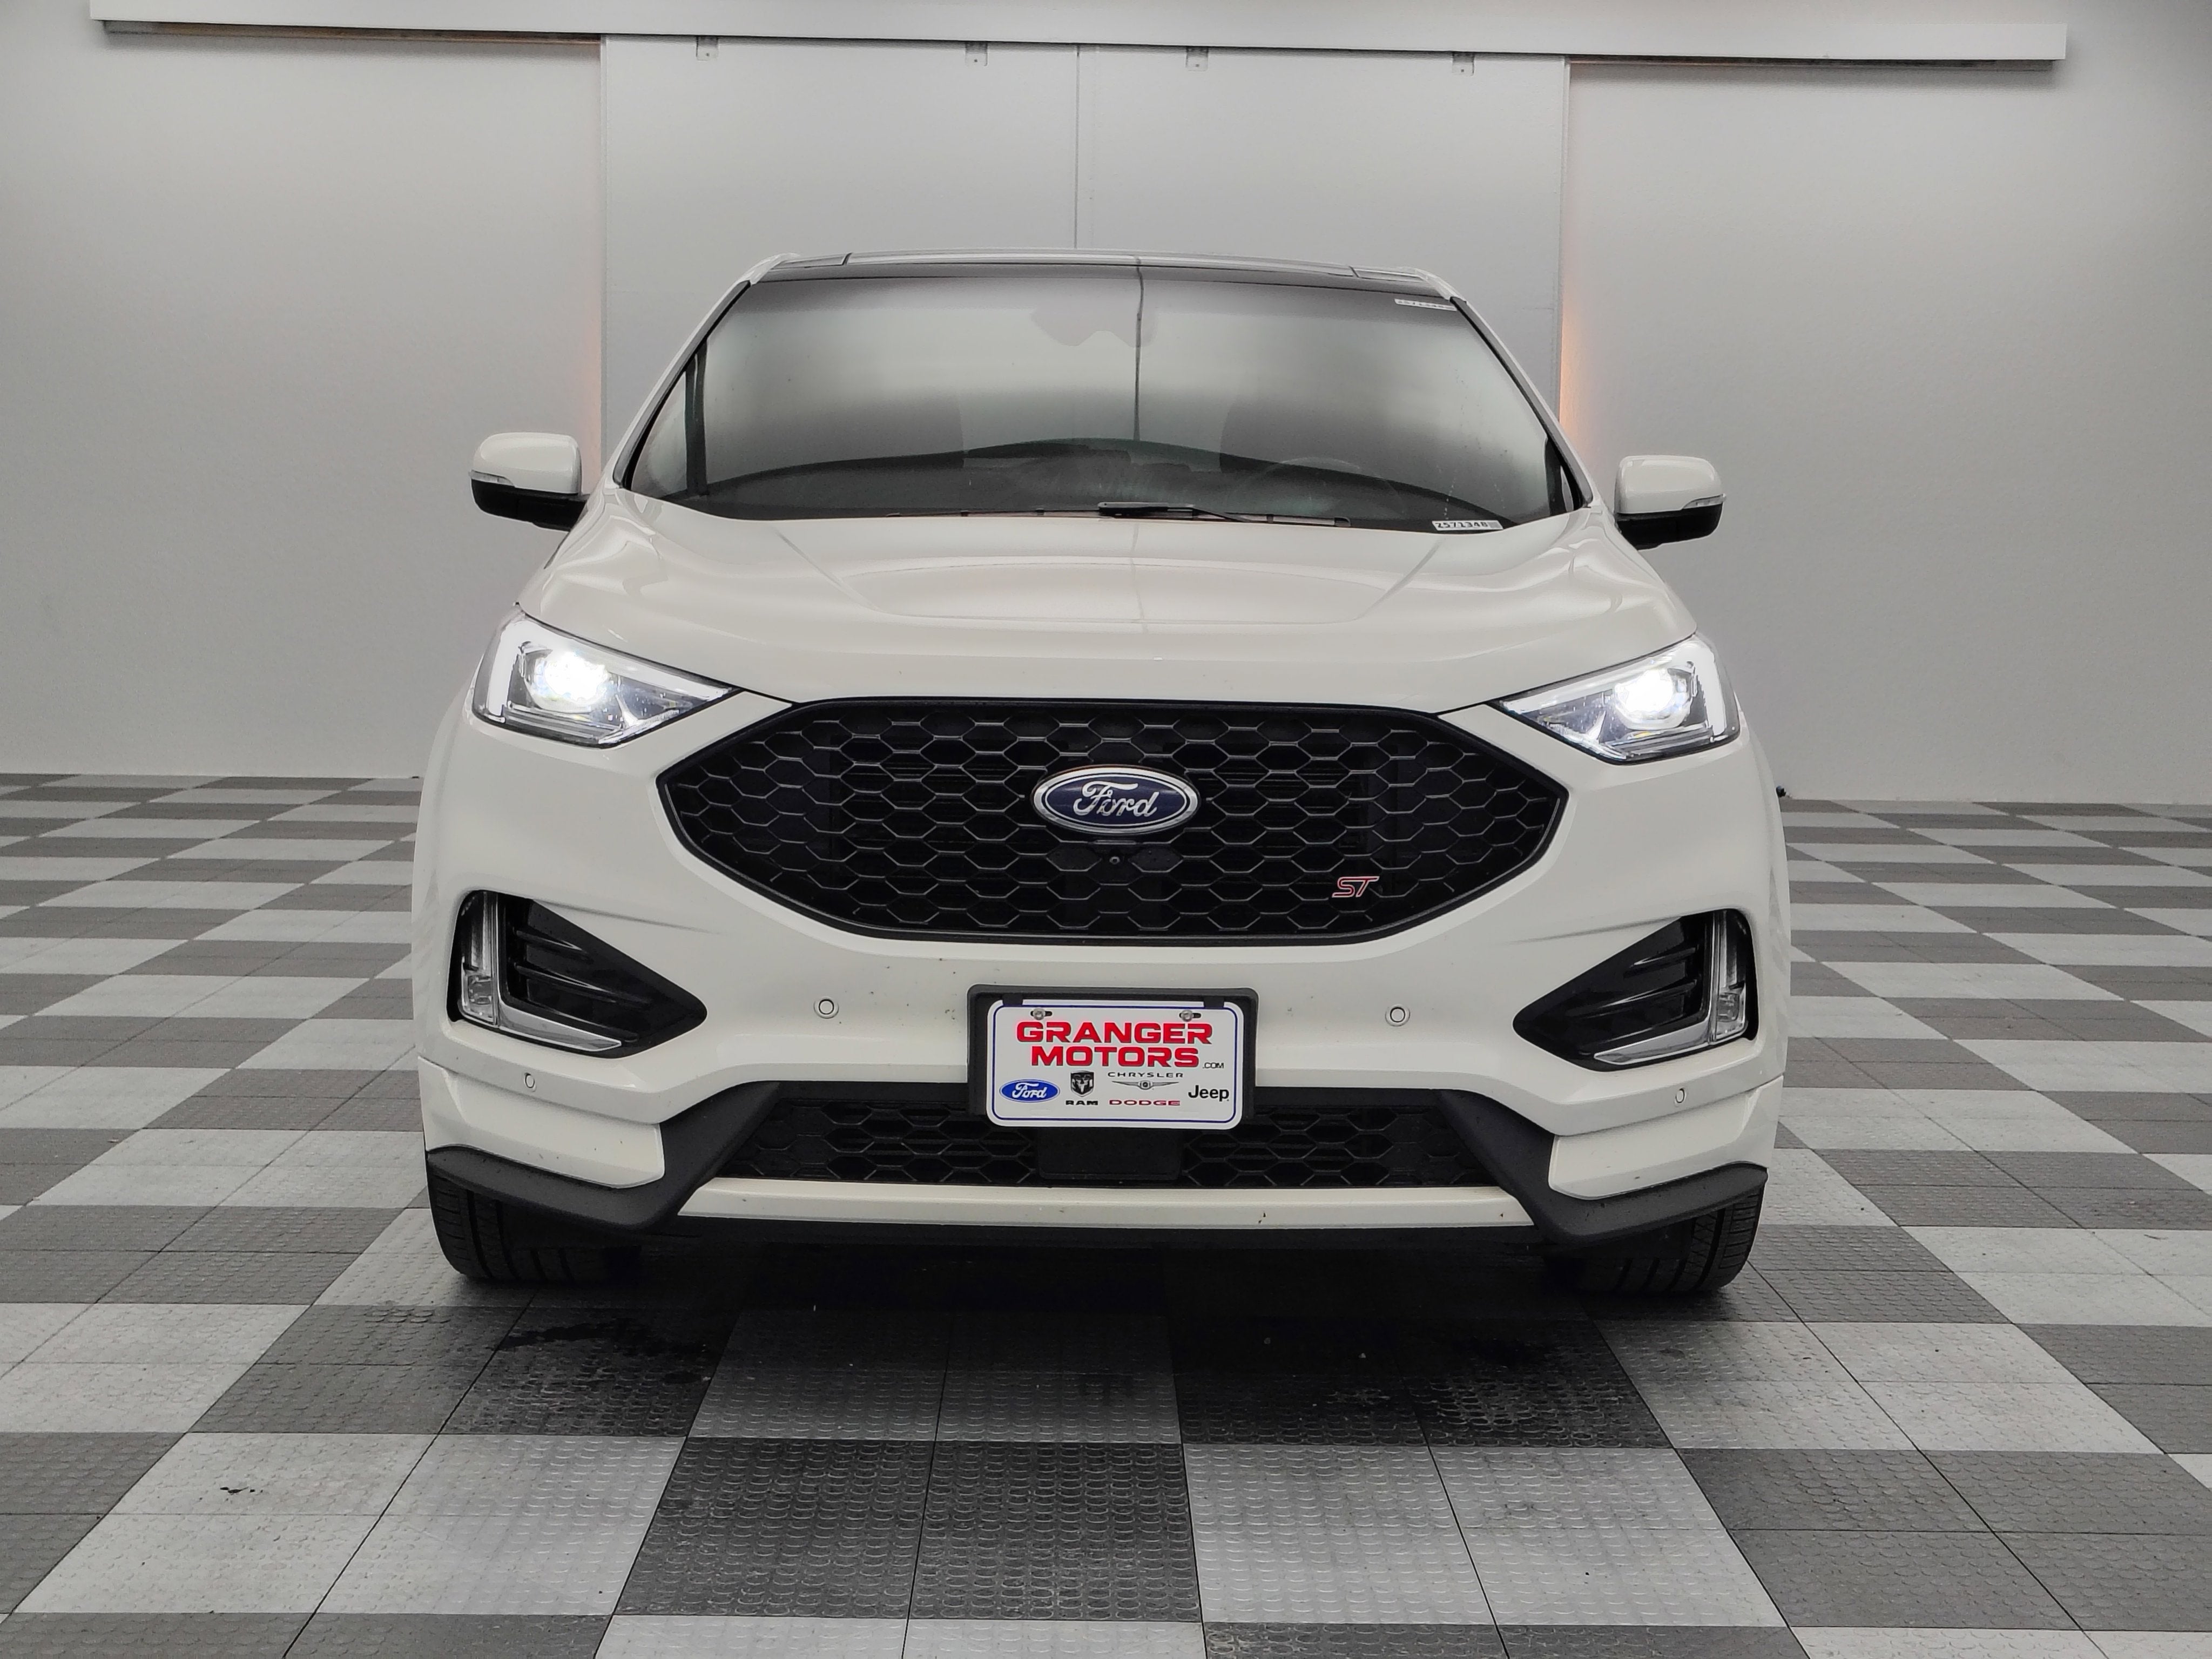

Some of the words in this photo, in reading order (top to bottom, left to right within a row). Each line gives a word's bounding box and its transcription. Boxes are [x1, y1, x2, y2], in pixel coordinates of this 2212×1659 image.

[1073, 781, 1159, 817] Ford
[1332, 876, 1380, 898] ST
[1016, 1021, 1212, 1044] GRANGER
[1031, 1046, 1199, 1068] MOTORS
[1011, 1082, 1047, 1098] Ford
[1188, 1085, 1229, 1101] Jeep
